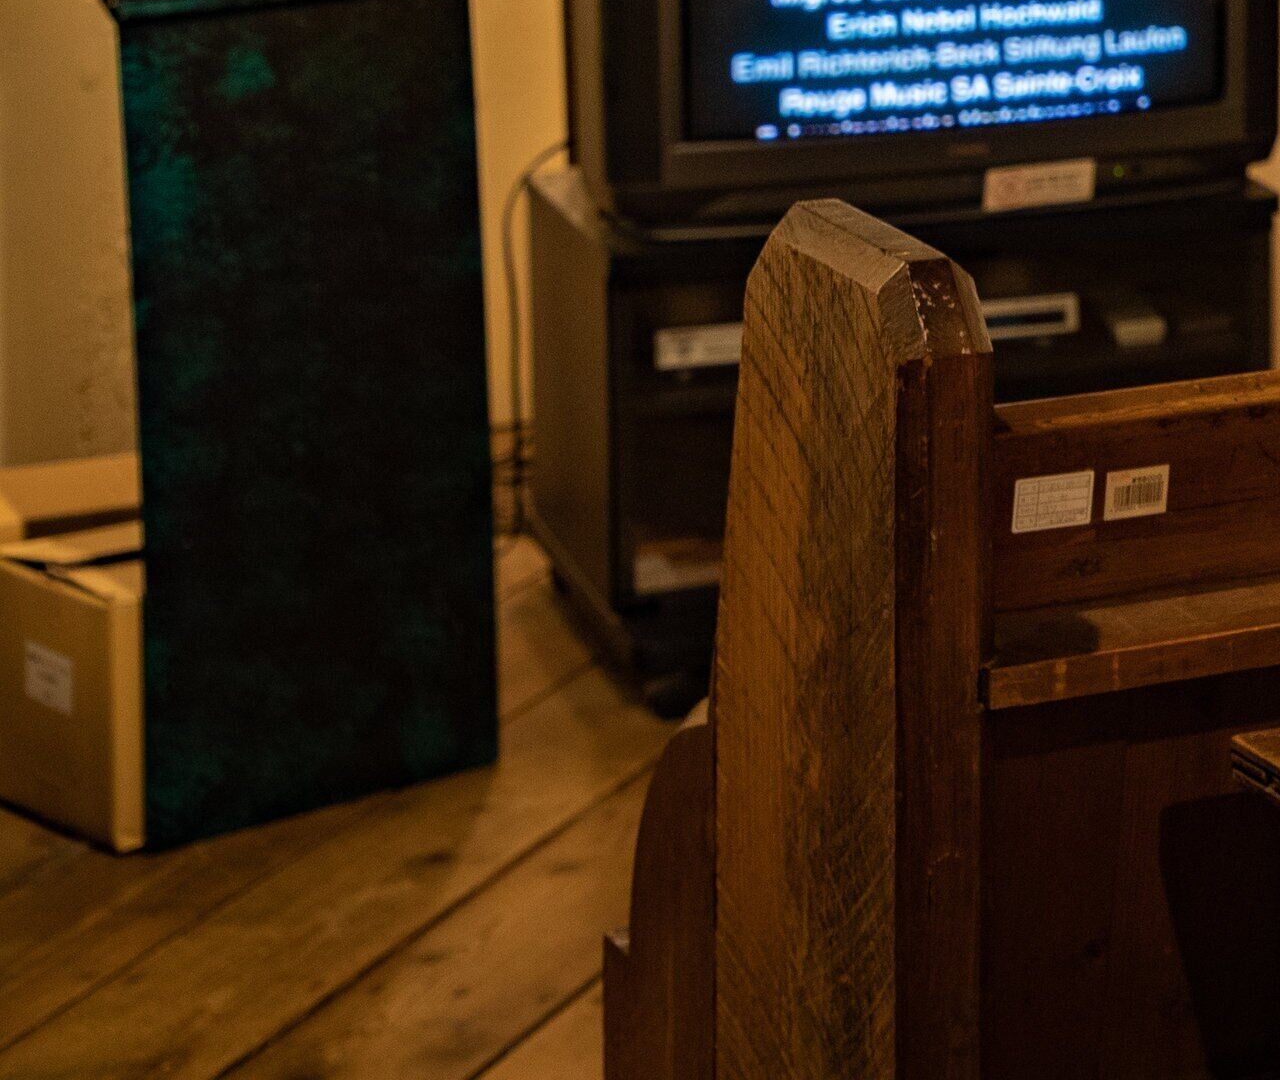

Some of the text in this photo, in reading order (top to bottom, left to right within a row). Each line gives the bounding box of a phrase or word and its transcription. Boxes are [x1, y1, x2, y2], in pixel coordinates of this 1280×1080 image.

[826, 11, 898, 41] Erich
[730, 51, 795, 83] Emil
[1003, 34, 1101, 63] Stiftung
[1103, 25, 1188, 57] Laufen
[869, 79, 949, 110] Music
[950, 73, 991, 103] SA
